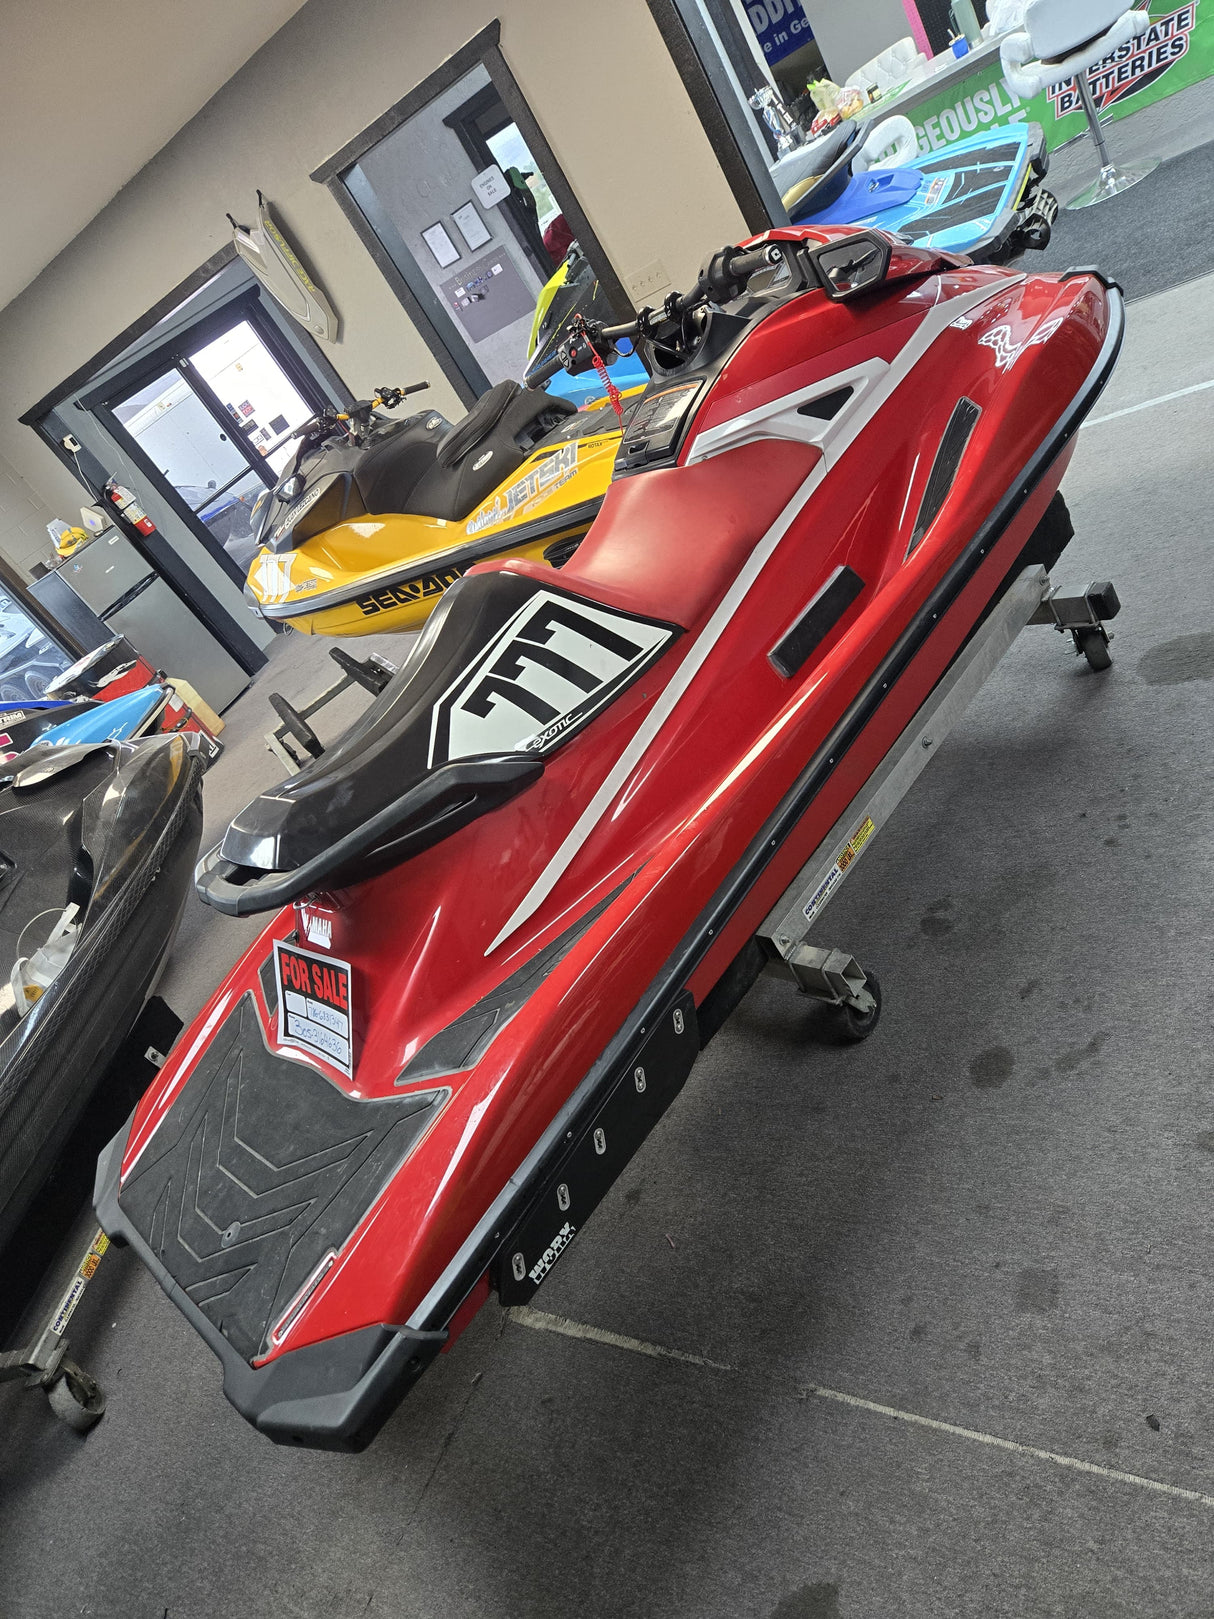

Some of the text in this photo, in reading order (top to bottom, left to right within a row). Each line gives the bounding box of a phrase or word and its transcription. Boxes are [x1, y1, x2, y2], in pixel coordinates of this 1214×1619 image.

[773, 31, 789, 46] in
[1051, 9, 1191, 95] INERSTATE
[460, 600, 644, 726] 777
[804, 867, 839, 916] CONTINENTAL
[280, 952, 348, 1011] FOR SALE
[528, 1221, 577, 1285] WORX
[53, 1280, 83, 1332] CONTINENTAL
